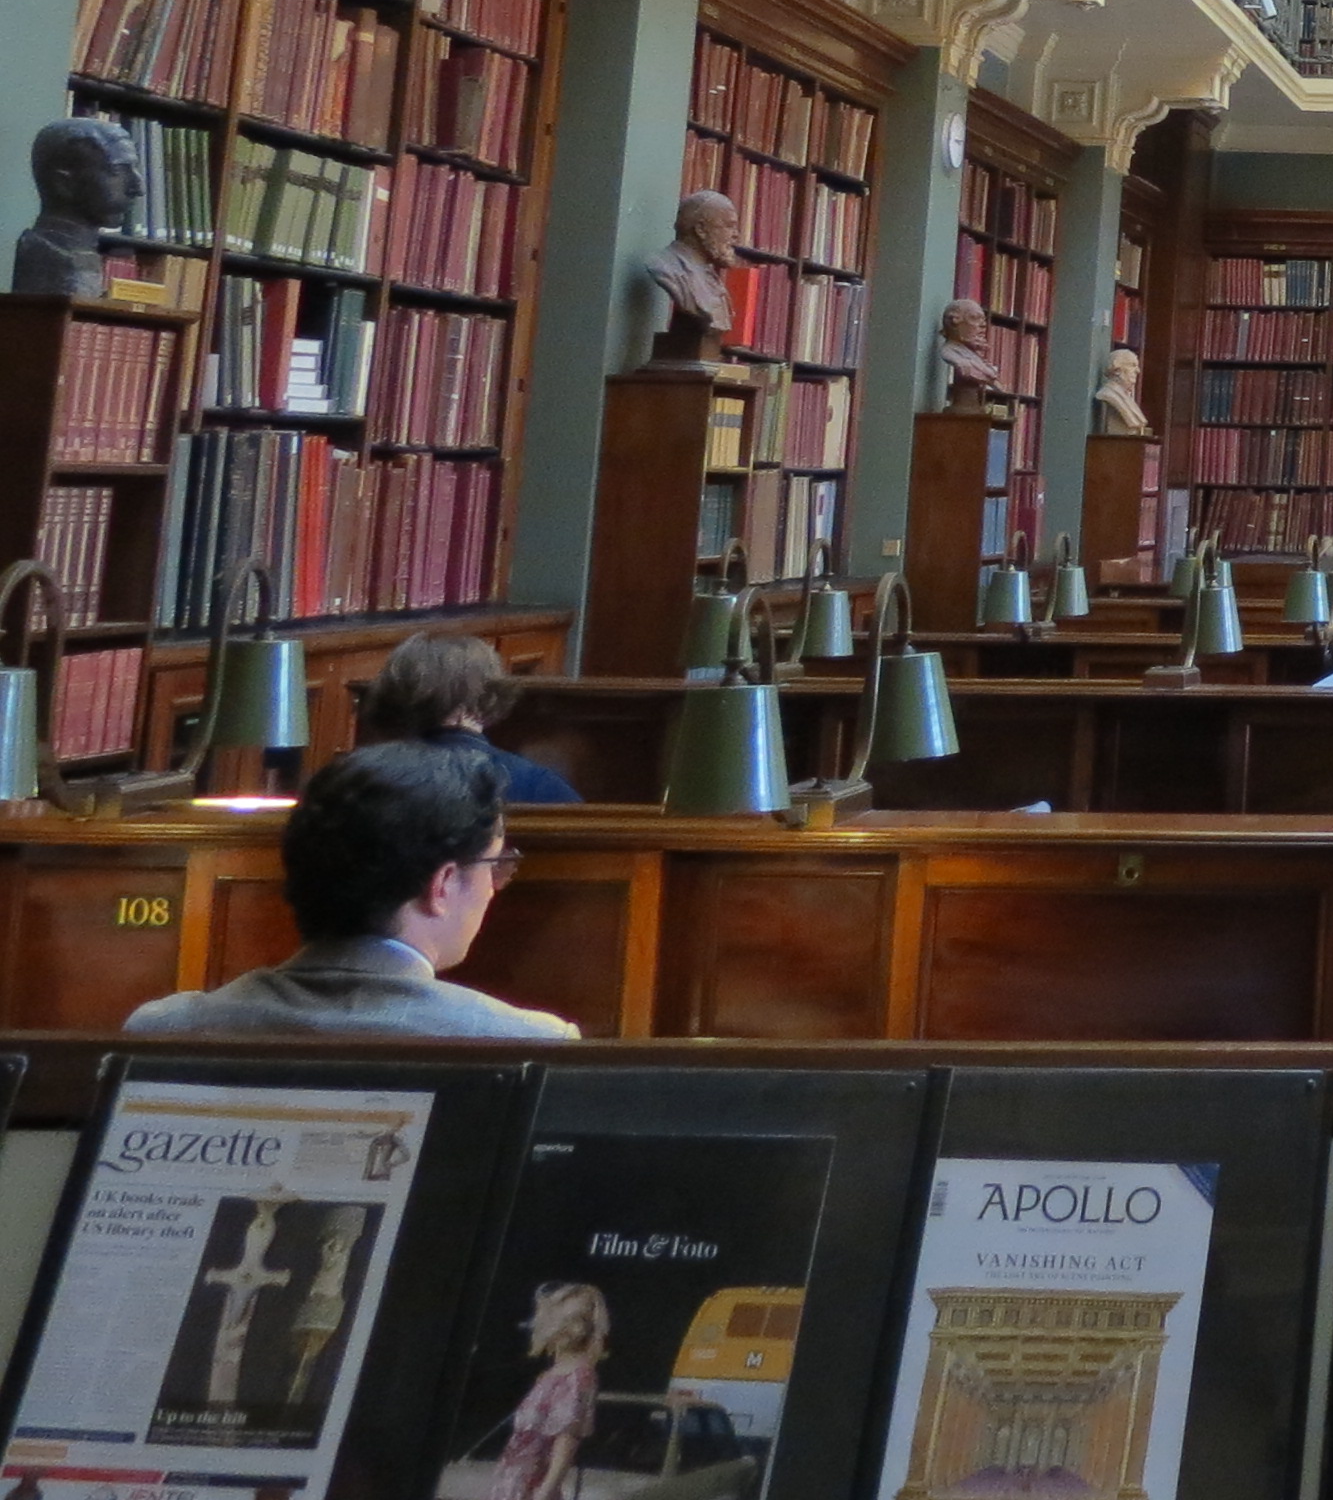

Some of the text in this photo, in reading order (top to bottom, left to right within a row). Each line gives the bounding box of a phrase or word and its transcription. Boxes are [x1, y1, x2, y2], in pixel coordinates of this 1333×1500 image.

[118, 896, 170, 926] 108
[97, 1128, 282, 1173] gazette
[976, 1182, 1163, 1224] APOLLO
[588, 1232, 719, 1259] Film & Foto
[976, 1252, 1148, 1272] VANISHING ACT
